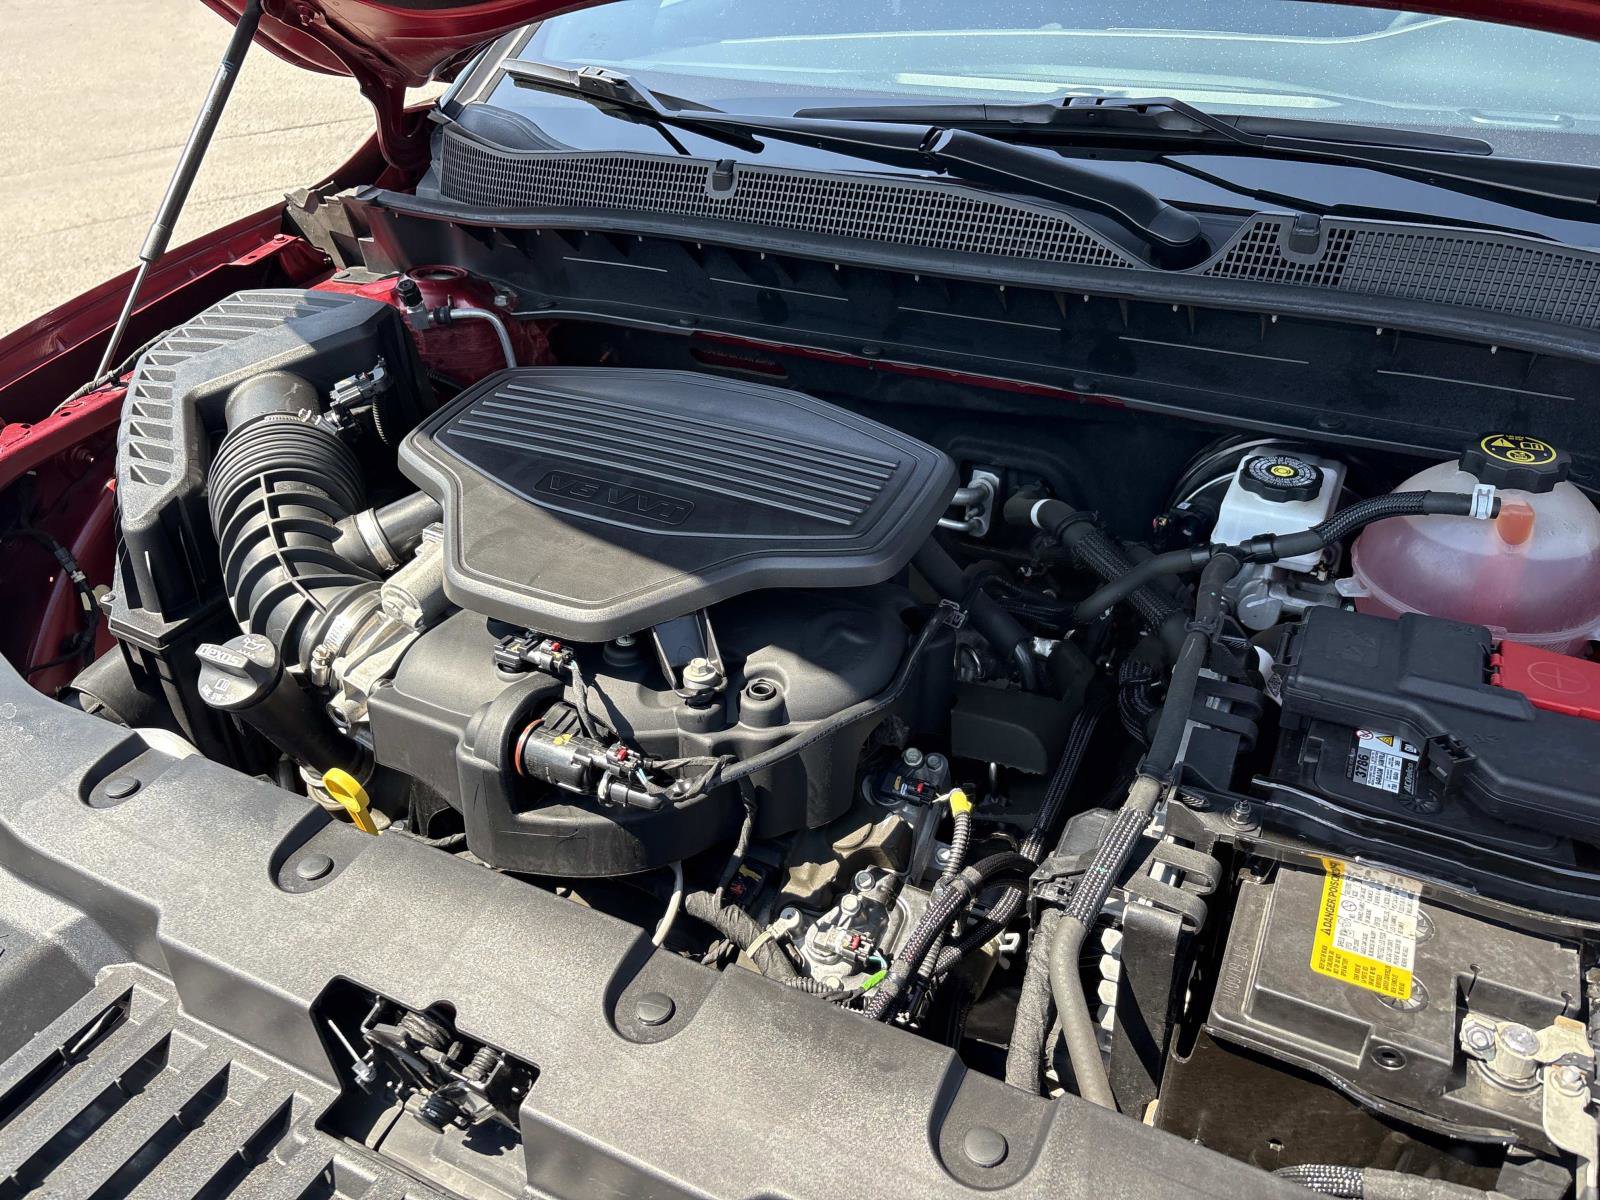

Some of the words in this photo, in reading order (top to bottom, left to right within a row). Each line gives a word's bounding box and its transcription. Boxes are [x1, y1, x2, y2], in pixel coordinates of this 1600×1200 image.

[550, 474, 599, 498] V6
[201, 645, 241, 664] dexos
[1355, 753, 1370, 779] 3786
